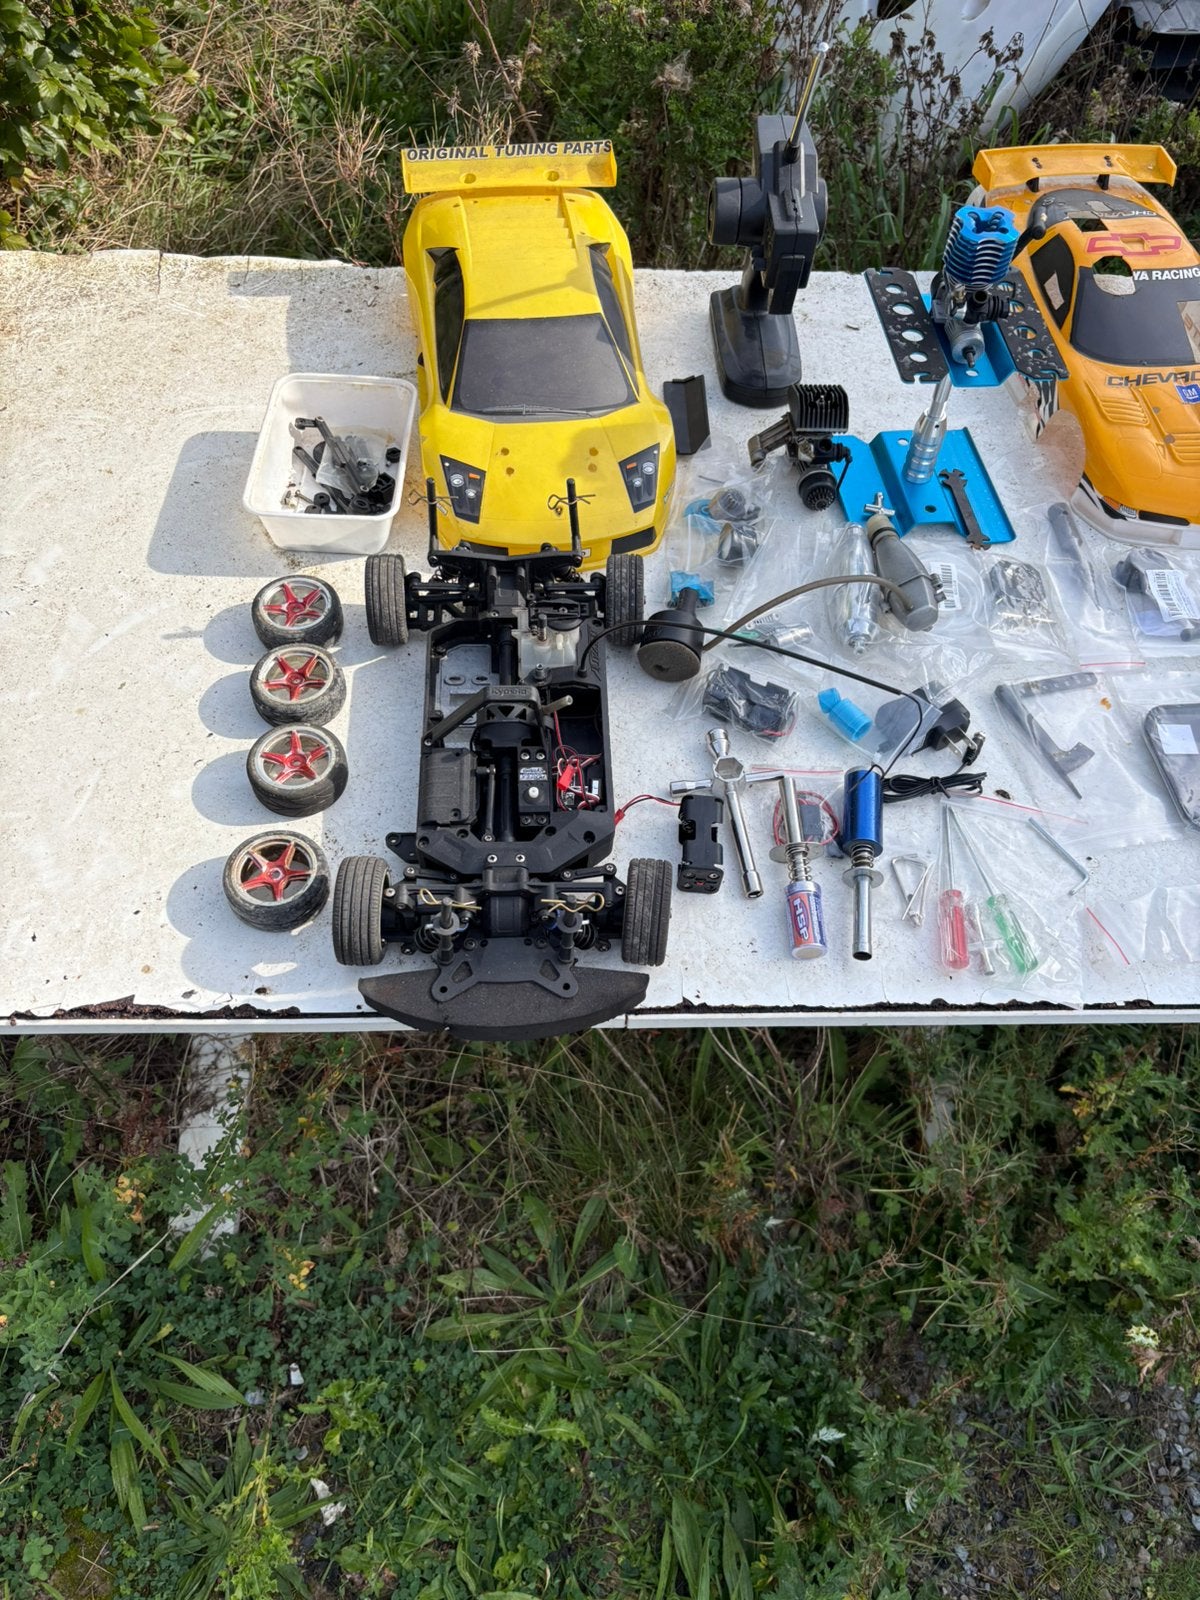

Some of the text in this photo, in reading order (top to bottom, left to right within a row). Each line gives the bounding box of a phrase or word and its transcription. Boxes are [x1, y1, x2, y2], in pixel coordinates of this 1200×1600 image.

[407, 139, 612, 161] ORIGINAL TUNING PARTS
[1152, 267, 1200, 281] RACING
[793, 898, 808, 940] HSP
